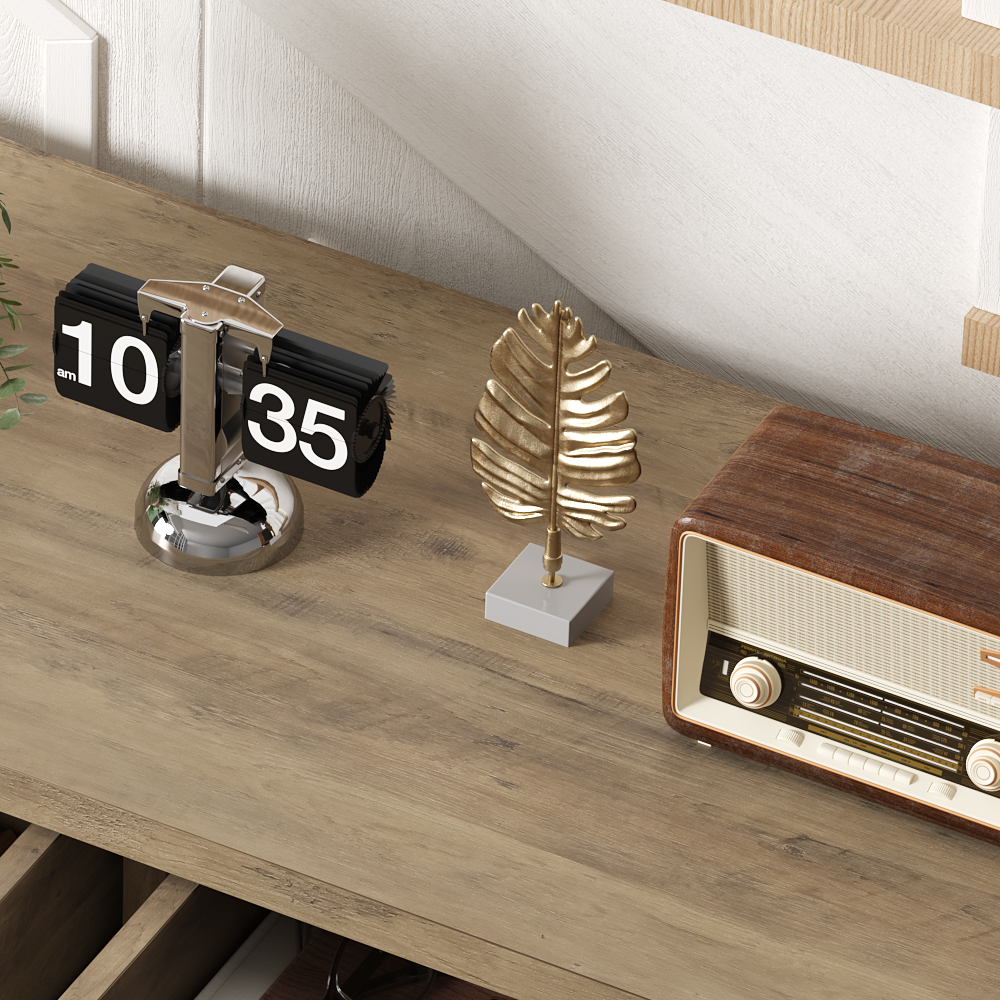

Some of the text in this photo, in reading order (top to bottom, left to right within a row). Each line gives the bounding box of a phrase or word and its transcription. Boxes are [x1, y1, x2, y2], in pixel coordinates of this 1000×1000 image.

[56, 366, 76, 382] am
[61, 320, 159, 405] 10
[247, 382, 348, 470] 35
